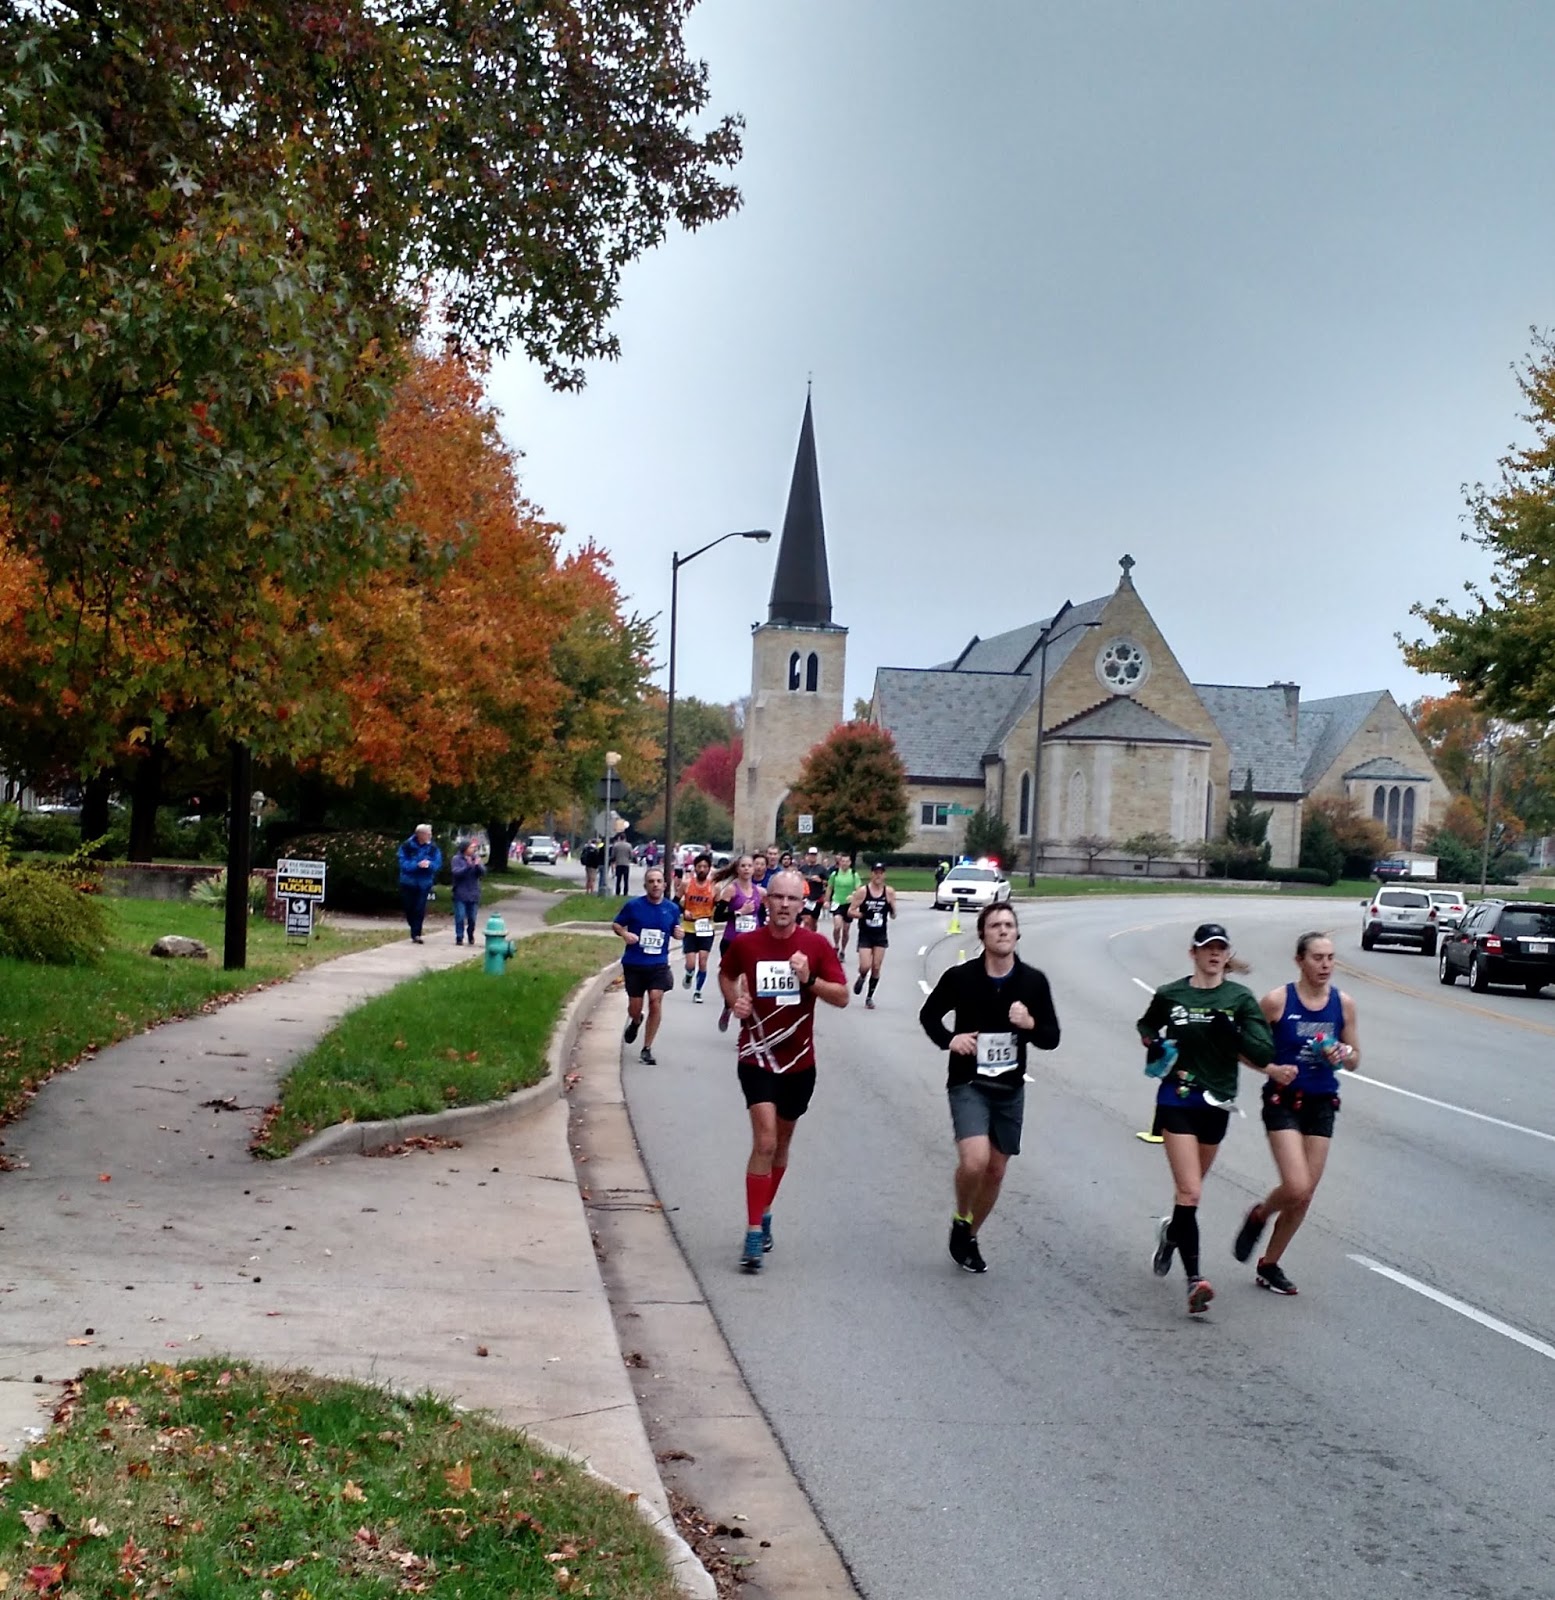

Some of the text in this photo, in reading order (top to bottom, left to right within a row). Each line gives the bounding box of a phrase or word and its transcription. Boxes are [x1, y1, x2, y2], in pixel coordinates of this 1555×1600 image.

[278, 882, 322, 894] TUCKER
[762, 976, 794, 990] 1166
[987, 1047, 1011, 1062] 615
